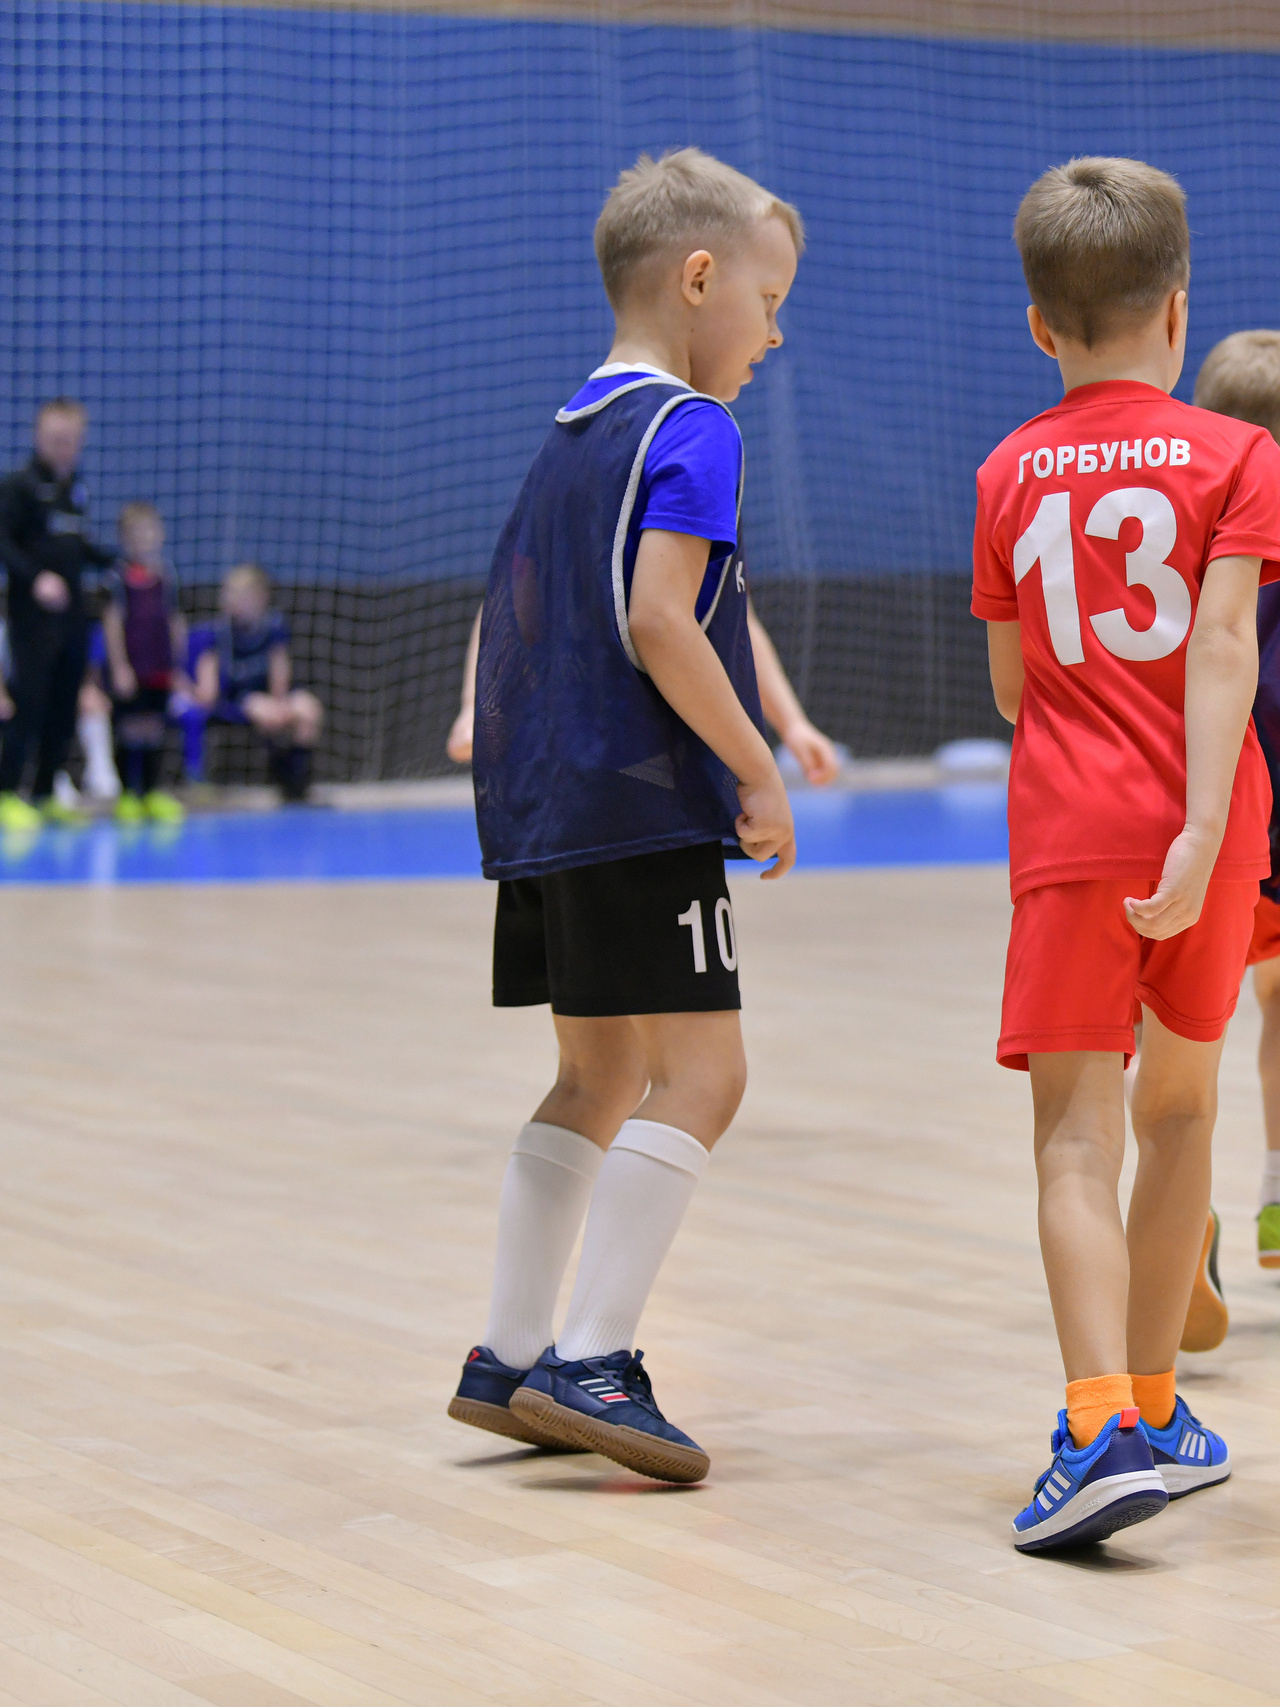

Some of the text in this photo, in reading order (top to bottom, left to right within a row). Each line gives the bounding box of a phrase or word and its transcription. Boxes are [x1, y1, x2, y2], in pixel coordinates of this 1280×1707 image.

[1017, 436, 1191, 485] ГОРБУНОВ
[1012, 486, 1192, 667] 13
[678, 897, 738, 973] 10
